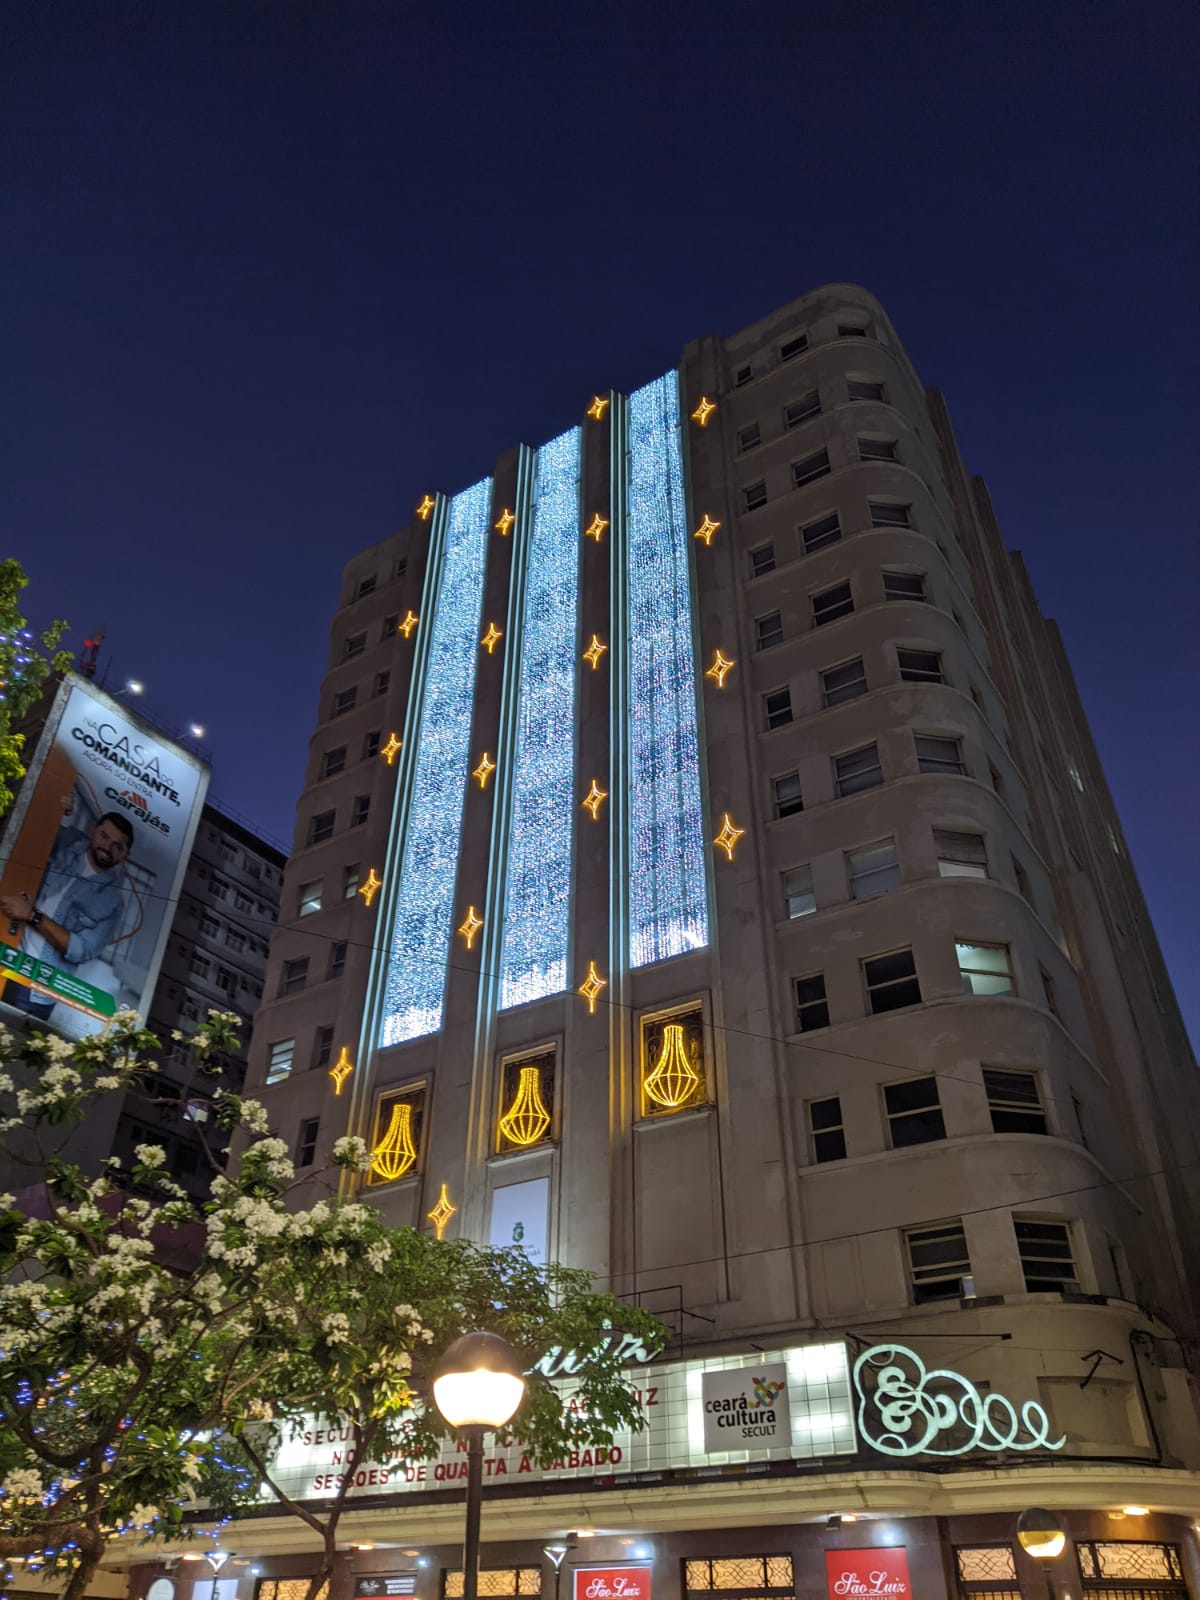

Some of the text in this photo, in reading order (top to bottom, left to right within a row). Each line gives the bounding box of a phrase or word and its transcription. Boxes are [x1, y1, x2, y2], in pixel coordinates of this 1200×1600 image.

[97, 723, 160, 779] CASA
[71, 727, 181, 807] COMANDANTE,
[82, 749, 113, 774] AGORA
[126, 778, 153, 798] ENTRA
[104, 786, 171, 834] Carajás
[705, 1391, 748, 1414] ceará
[716, 1409, 777, 1428] cultura
[741, 1424, 777, 1439] SECULT
[405, 1466, 427, 1482] DE
[434, 1458, 508, 1481] QUATA
[518, 1455, 532, 1473] A
[611, 1576, 641, 1598] Luiz
[868, 1570, 907, 1594] Luiz
